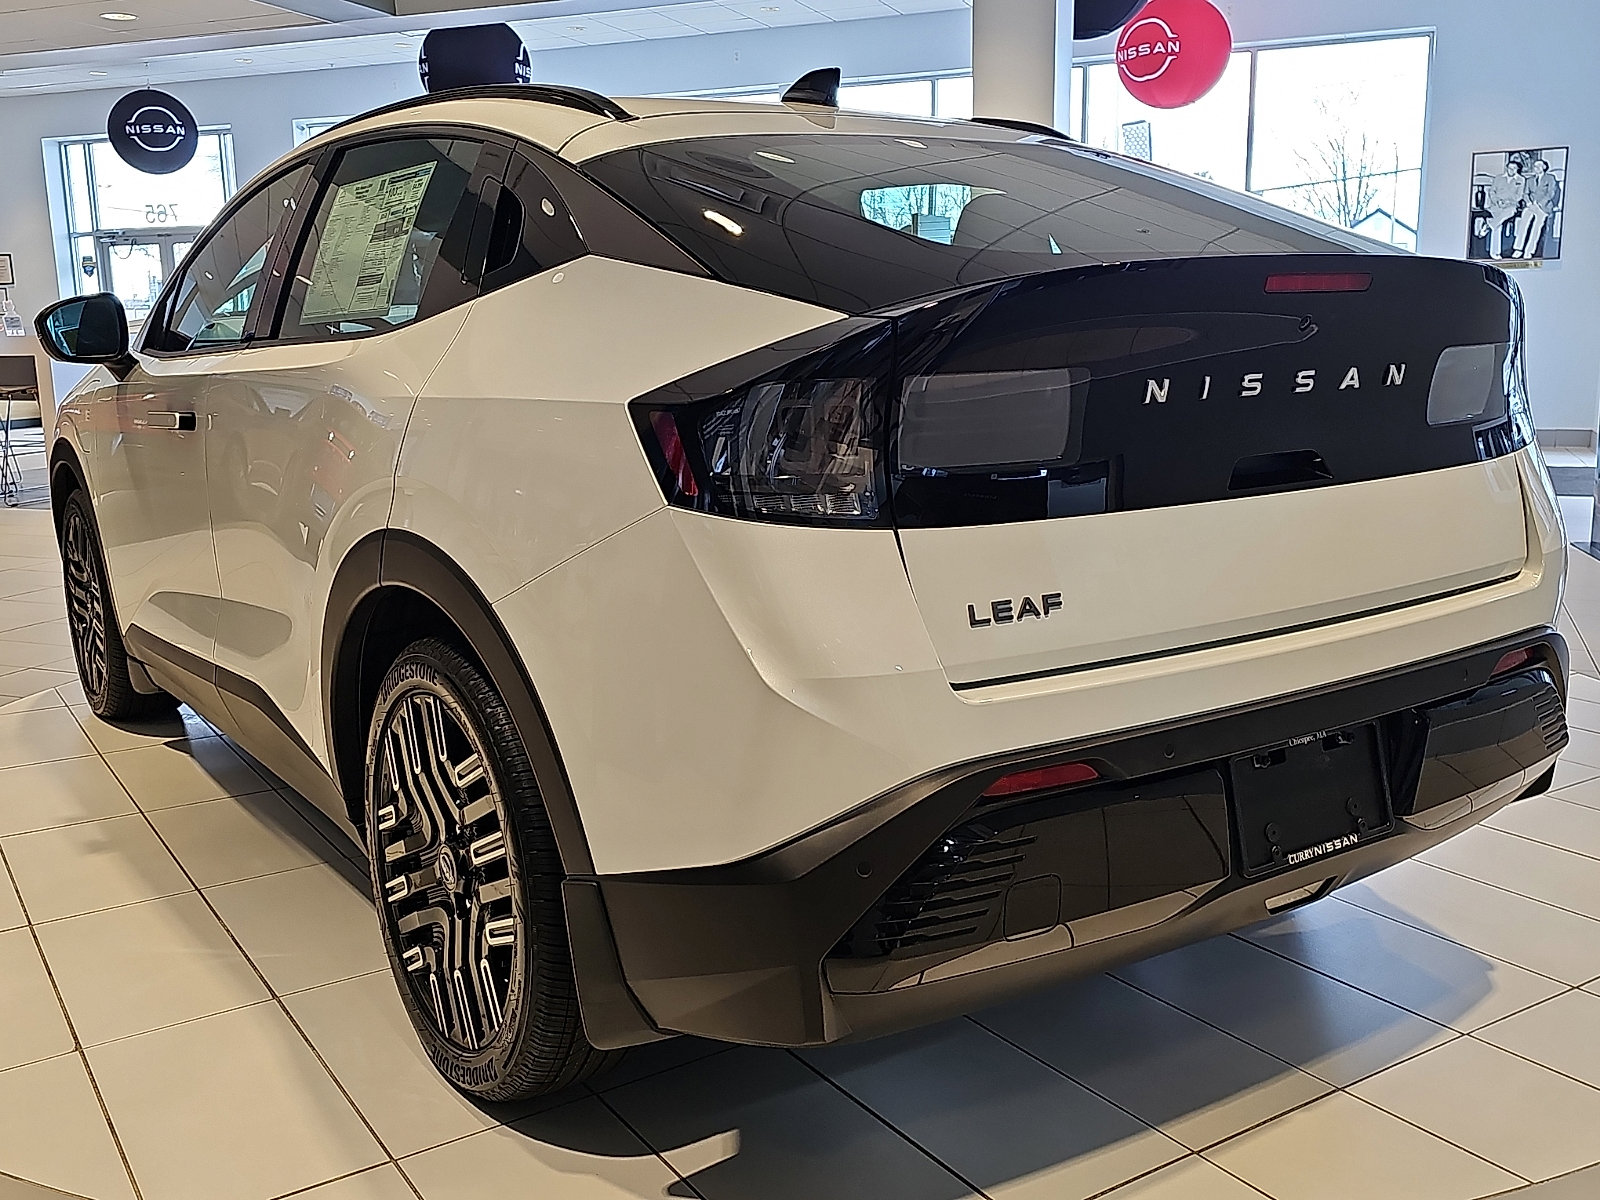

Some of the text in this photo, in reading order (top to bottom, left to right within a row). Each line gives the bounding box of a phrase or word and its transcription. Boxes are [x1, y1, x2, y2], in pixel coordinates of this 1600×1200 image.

[1117, 40, 1180, 63] NISSAN
[125, 124, 186, 136] NISSAN
[1142, 363, 1406, 405] NISSAN
[967, 592, 1063, 629] LEAF
